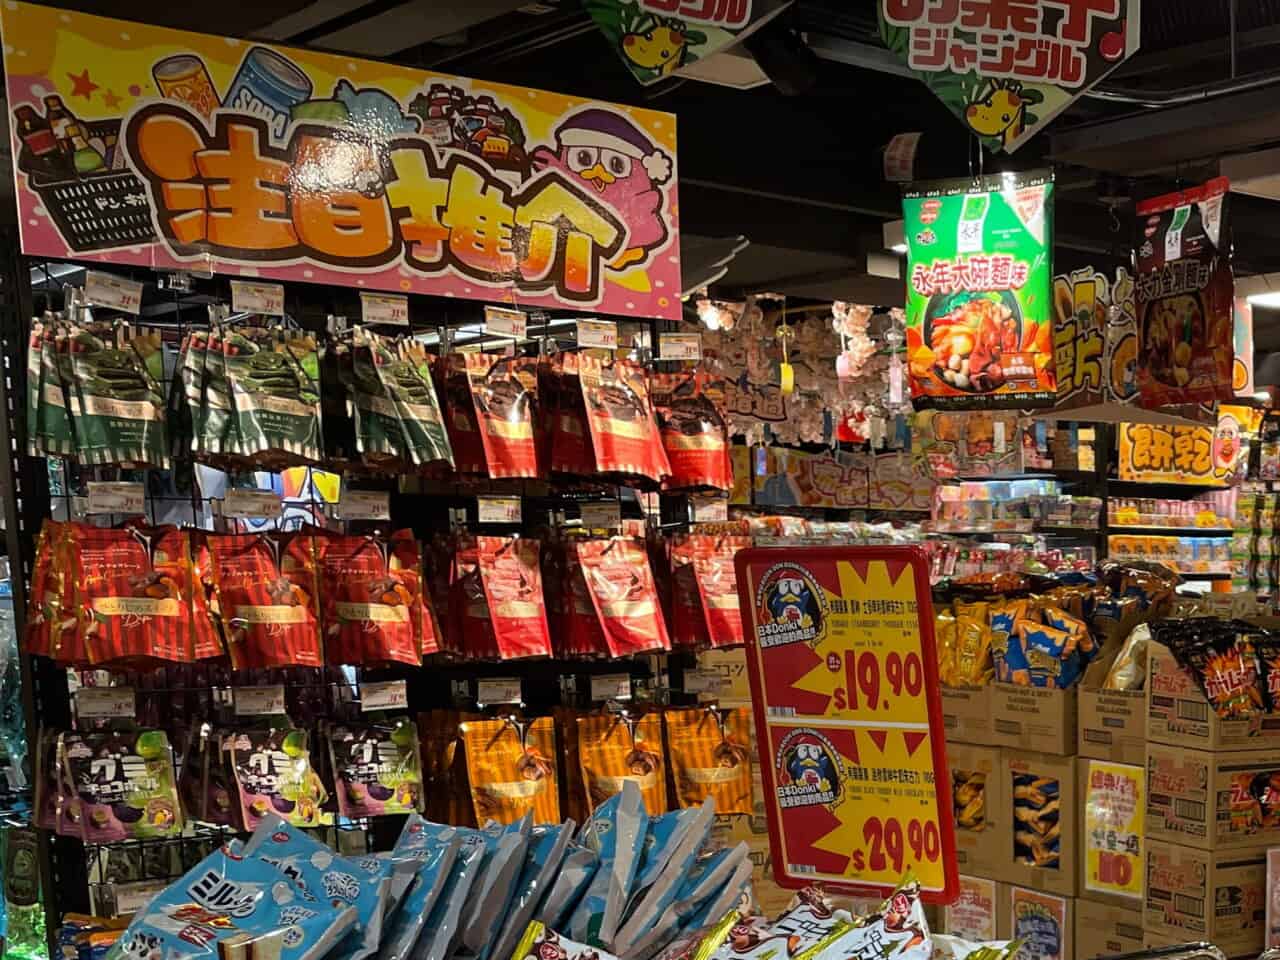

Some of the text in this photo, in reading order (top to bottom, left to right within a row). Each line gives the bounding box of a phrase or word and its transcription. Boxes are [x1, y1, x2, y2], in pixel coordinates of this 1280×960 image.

[912, 27, 1083, 84] ジャングル
[233, 88, 287, 137] SODA
[131, 106, 622, 303] 注目推介
